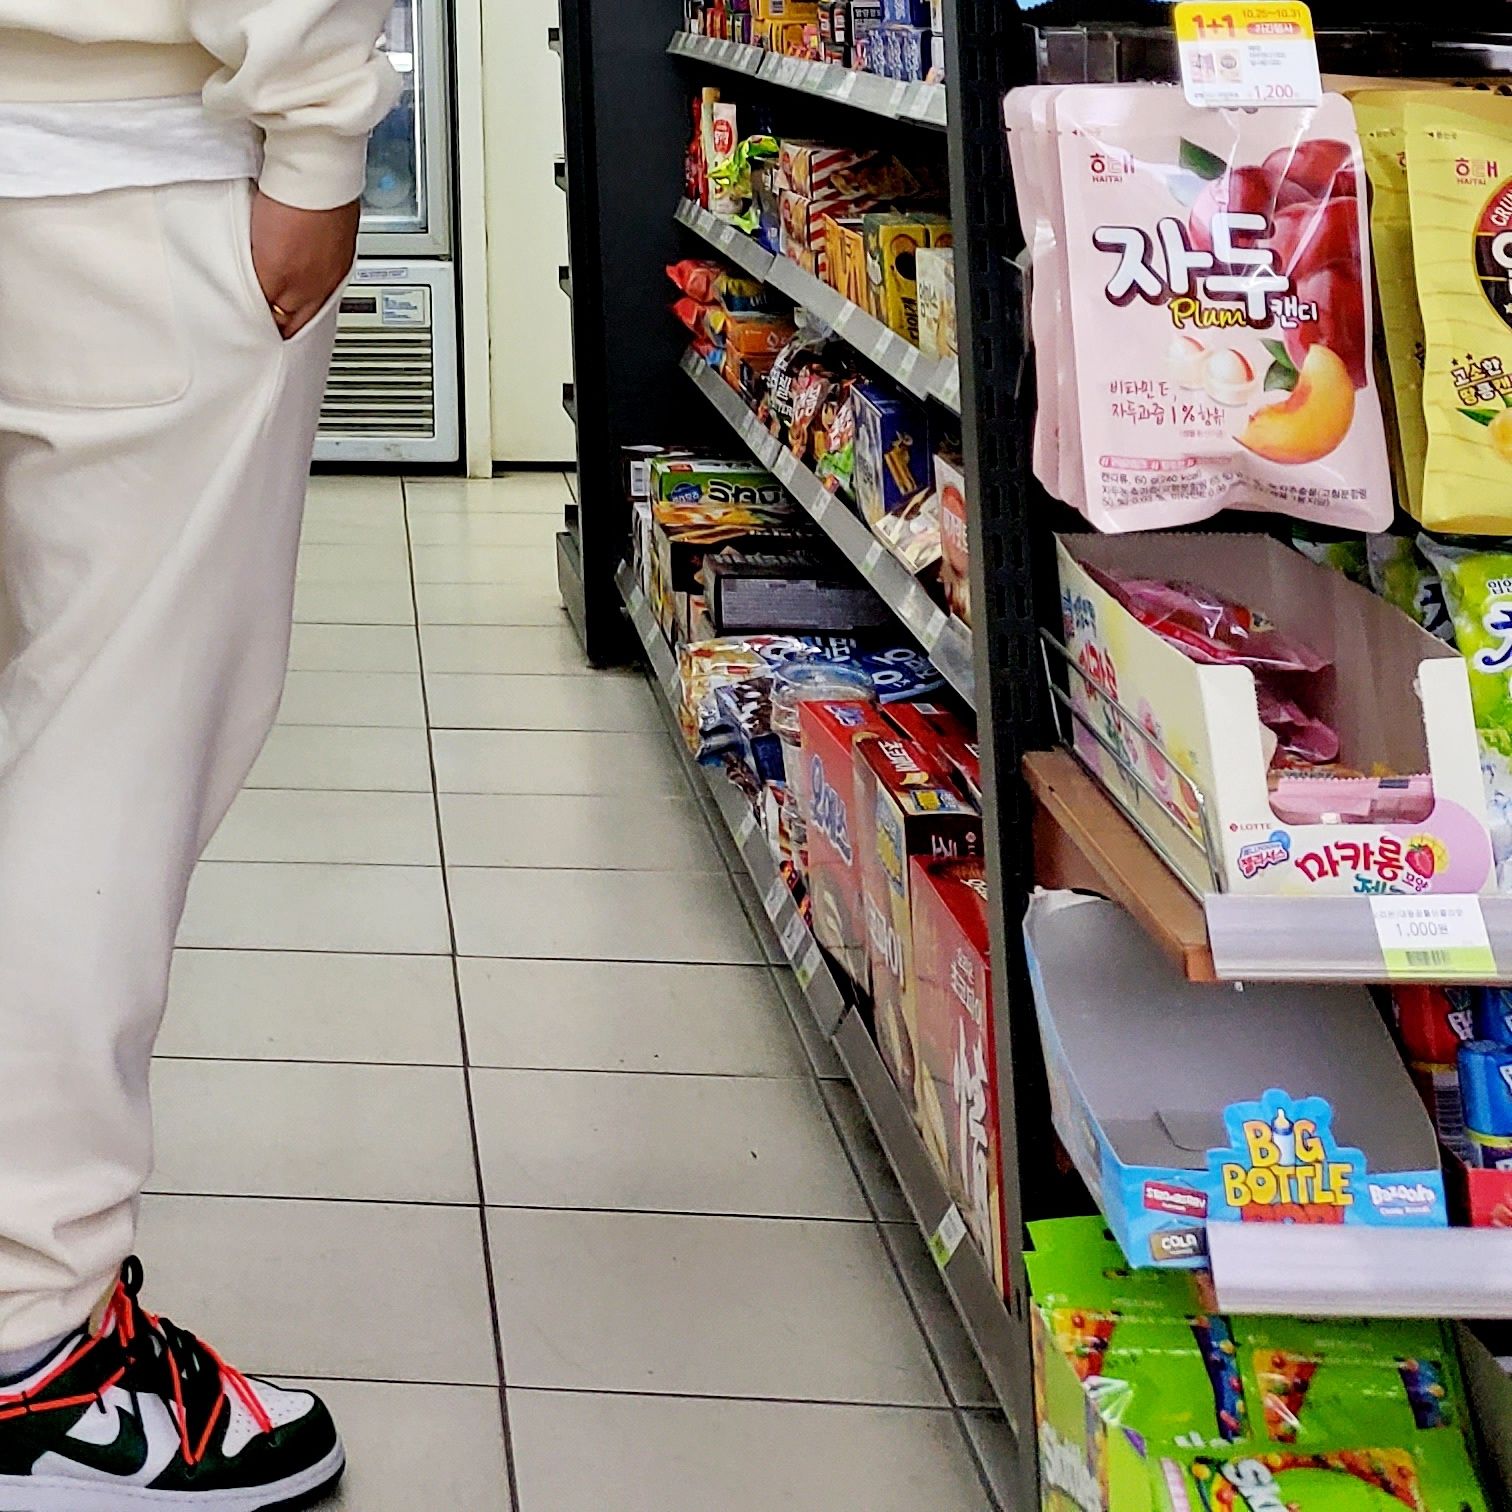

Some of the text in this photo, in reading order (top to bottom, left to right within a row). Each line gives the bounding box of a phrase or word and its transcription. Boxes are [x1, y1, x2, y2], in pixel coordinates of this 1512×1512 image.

[1192, 14, 1235, 38] 1+1
[1094, 213, 1288, 321] 자두
[1170, 298, 1246, 329] Plum
[1271, 296, 1317, 327] 캔디
[1110, 381, 1155, 398] 비타민
[1112, 402, 1225, 426] 자두과즙 함유
[1295, 836, 1404, 882] 마카롱
[1397, 922, 1448, 937] 1,000원
[1223, 1163, 1354, 1207] BOTTLE
[1162, 1234, 1197, 1250] COLA
